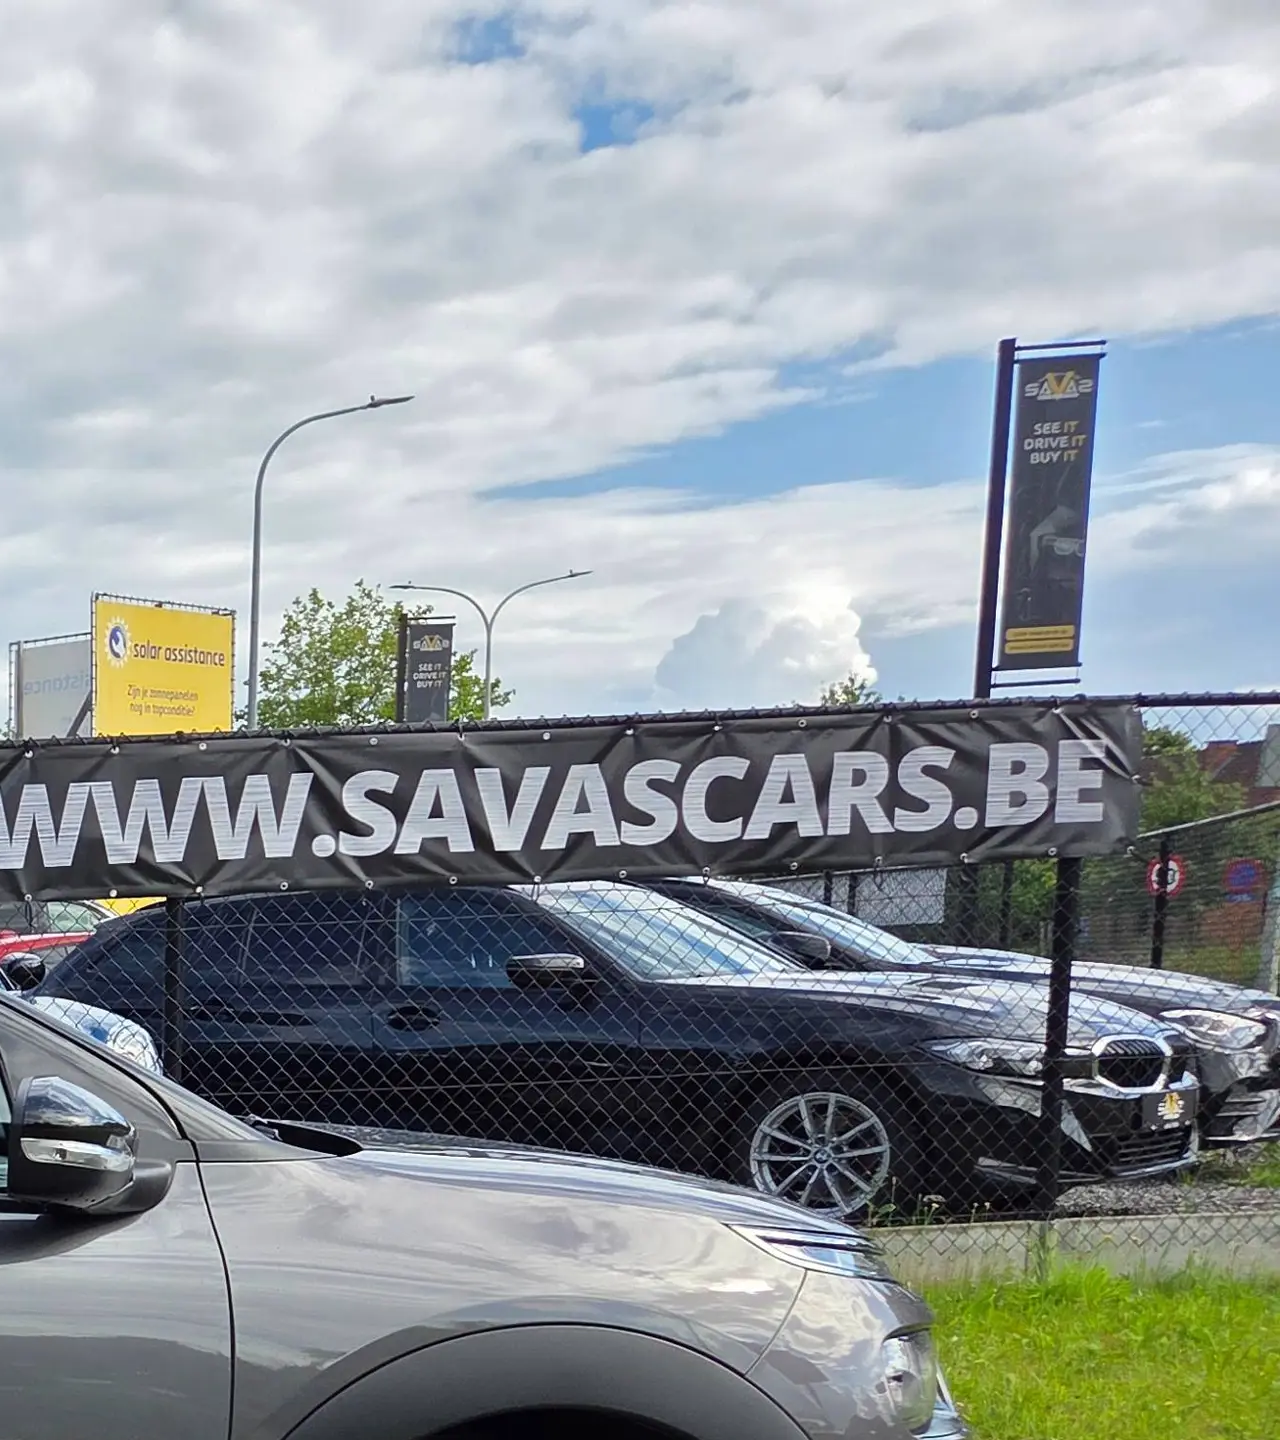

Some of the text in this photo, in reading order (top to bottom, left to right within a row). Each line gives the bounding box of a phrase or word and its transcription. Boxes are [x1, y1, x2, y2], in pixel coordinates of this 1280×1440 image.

[1033, 420, 1079, 435] SEE IT
[1023, 434, 1087, 450] DRIVE IT
[1030, 450, 1079, 464] BUY IT
[133, 640, 225, 667] solar assistance
